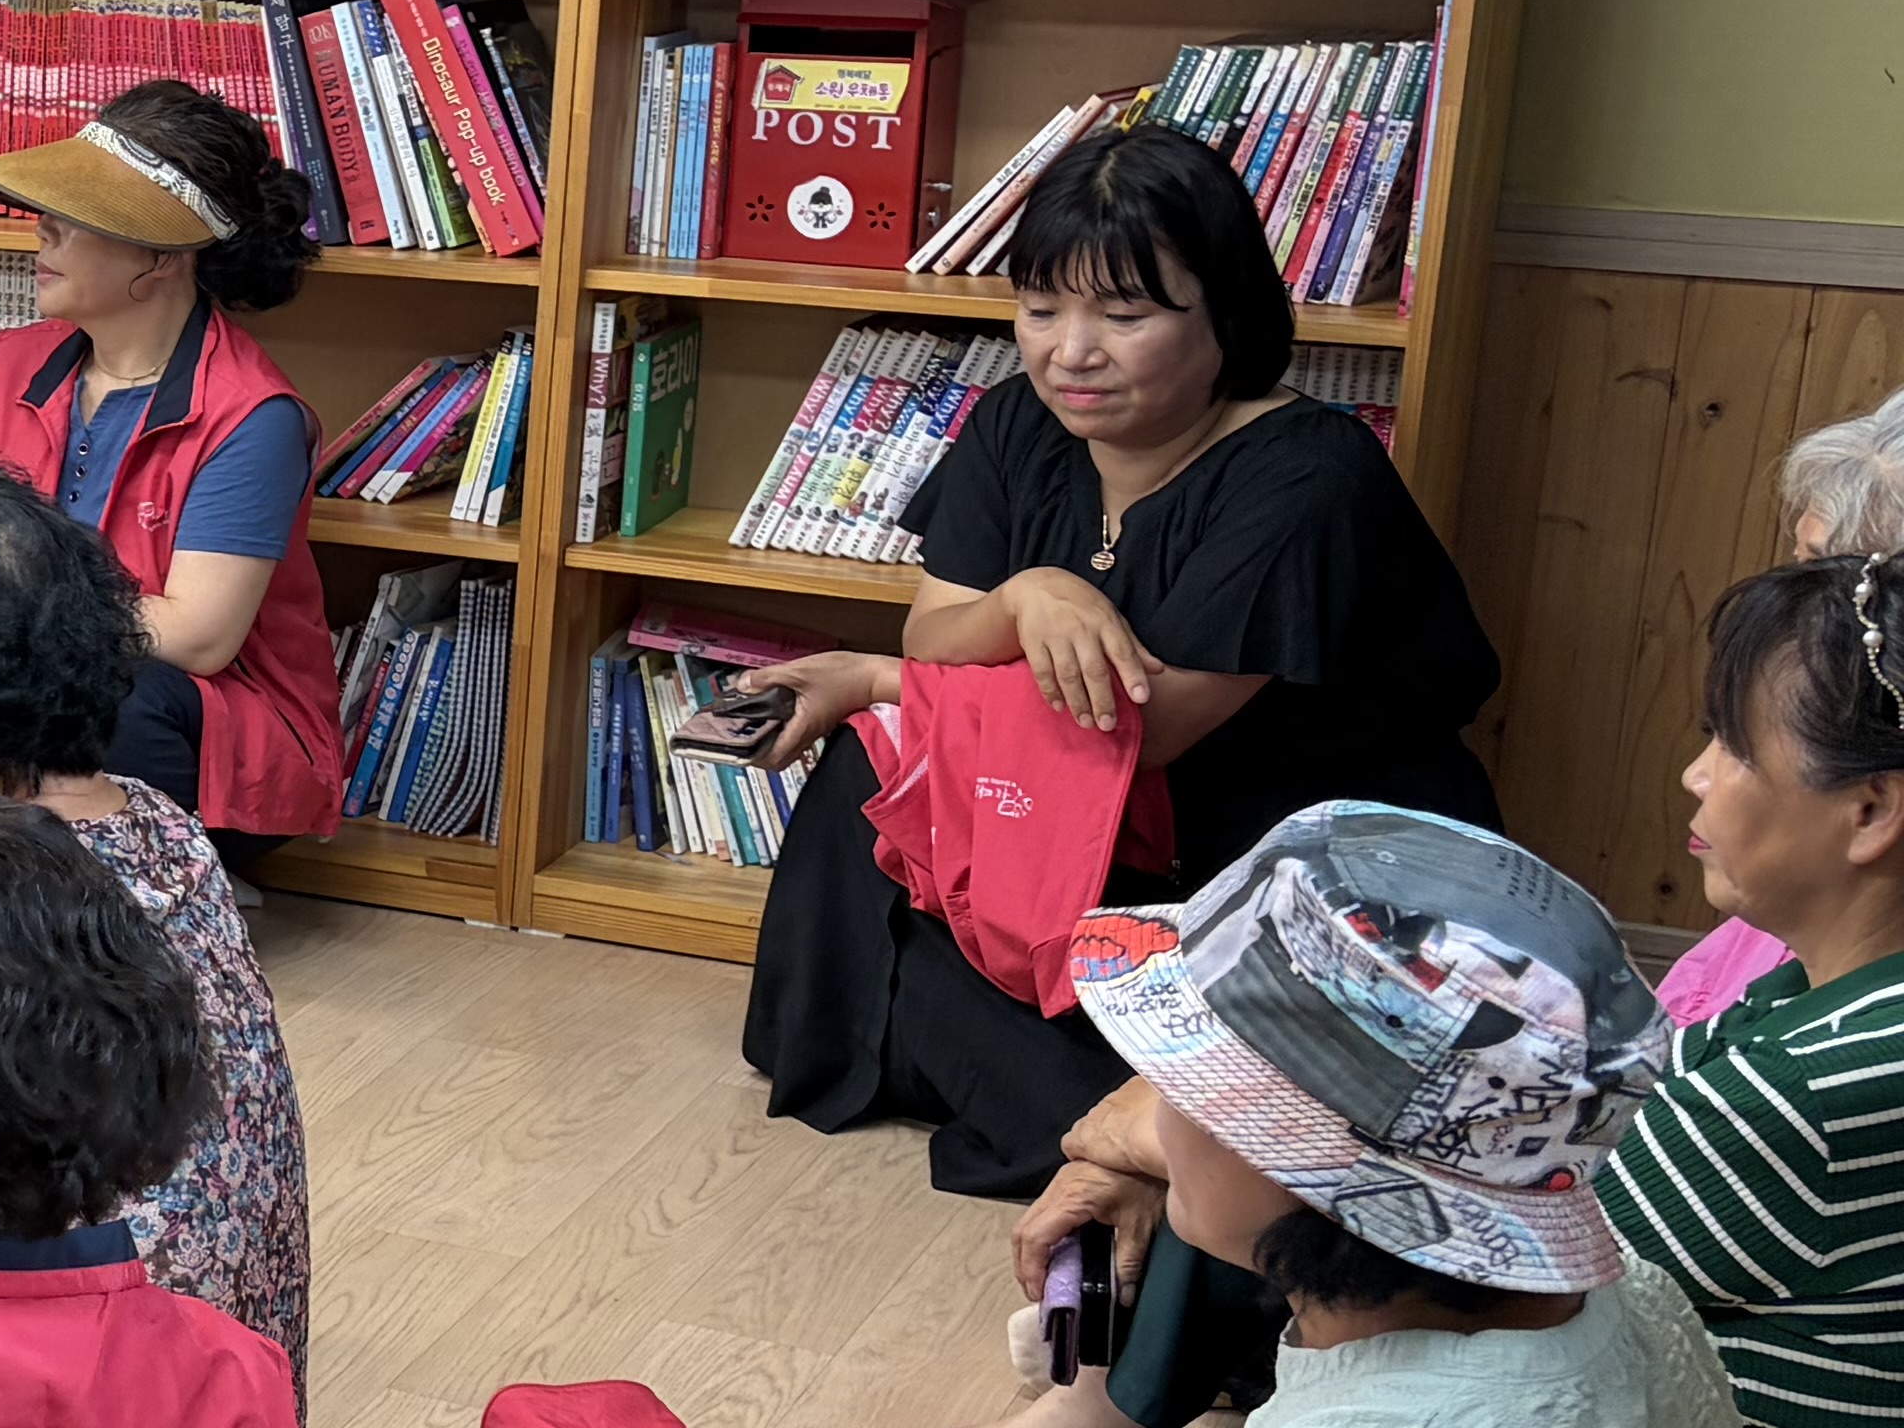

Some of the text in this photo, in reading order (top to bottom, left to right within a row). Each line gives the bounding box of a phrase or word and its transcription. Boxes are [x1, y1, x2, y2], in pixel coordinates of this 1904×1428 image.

[814, 81, 844, 99] 소원
[423, 36, 507, 207] Dinosaur Pop-up book
[751, 109, 901, 150] POST
[589, 356, 611, 409] Why?
[650, 333, 700, 404] 호라이
[802, 376, 834, 429] Why?
[840, 377, 875, 430] Why?
[860, 379, 892, 432] Why?
[876, 382, 912, 433] Why?
[931, 384, 967, 439] Why?
